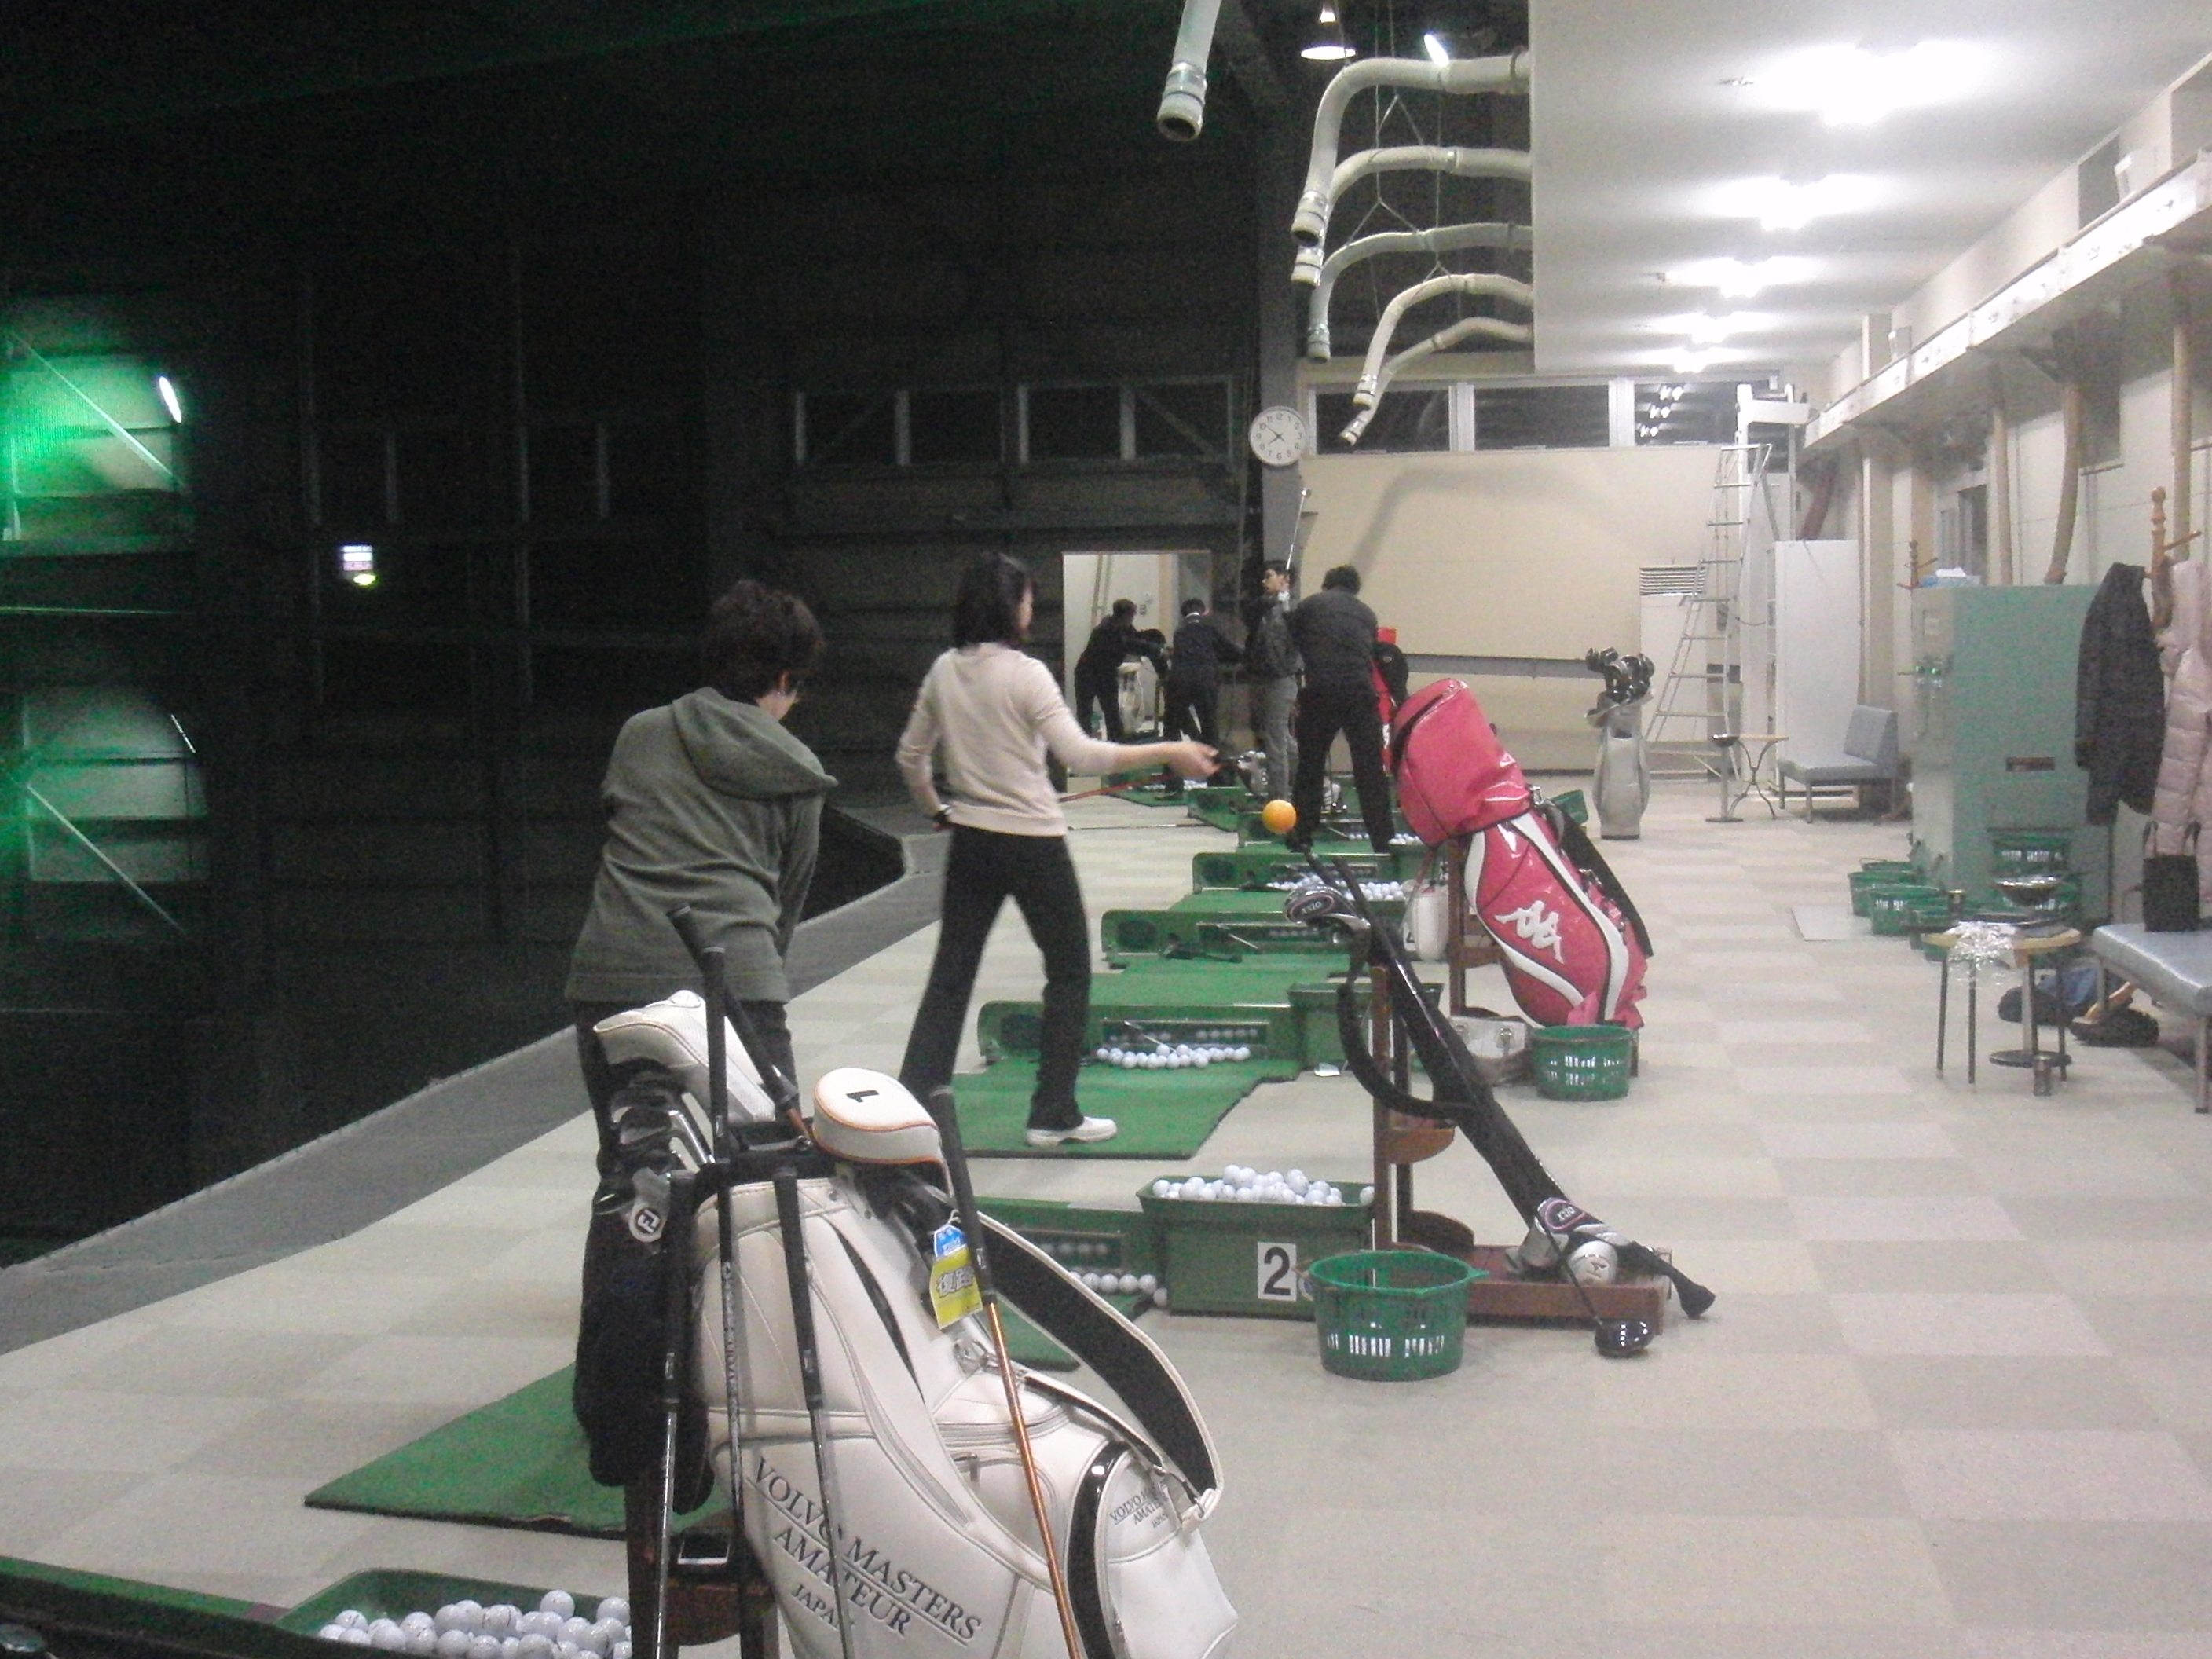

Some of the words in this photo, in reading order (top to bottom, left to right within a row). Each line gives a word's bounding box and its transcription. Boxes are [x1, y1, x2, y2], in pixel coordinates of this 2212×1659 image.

[846, 1090, 879, 1103] 1
[1263, 1246, 1291, 1296] 2
[1109, 1495, 1141, 1522] VOLVO
[791, 1583, 855, 1632] JAPA
[845, 1536, 982, 1639] MASTERS
